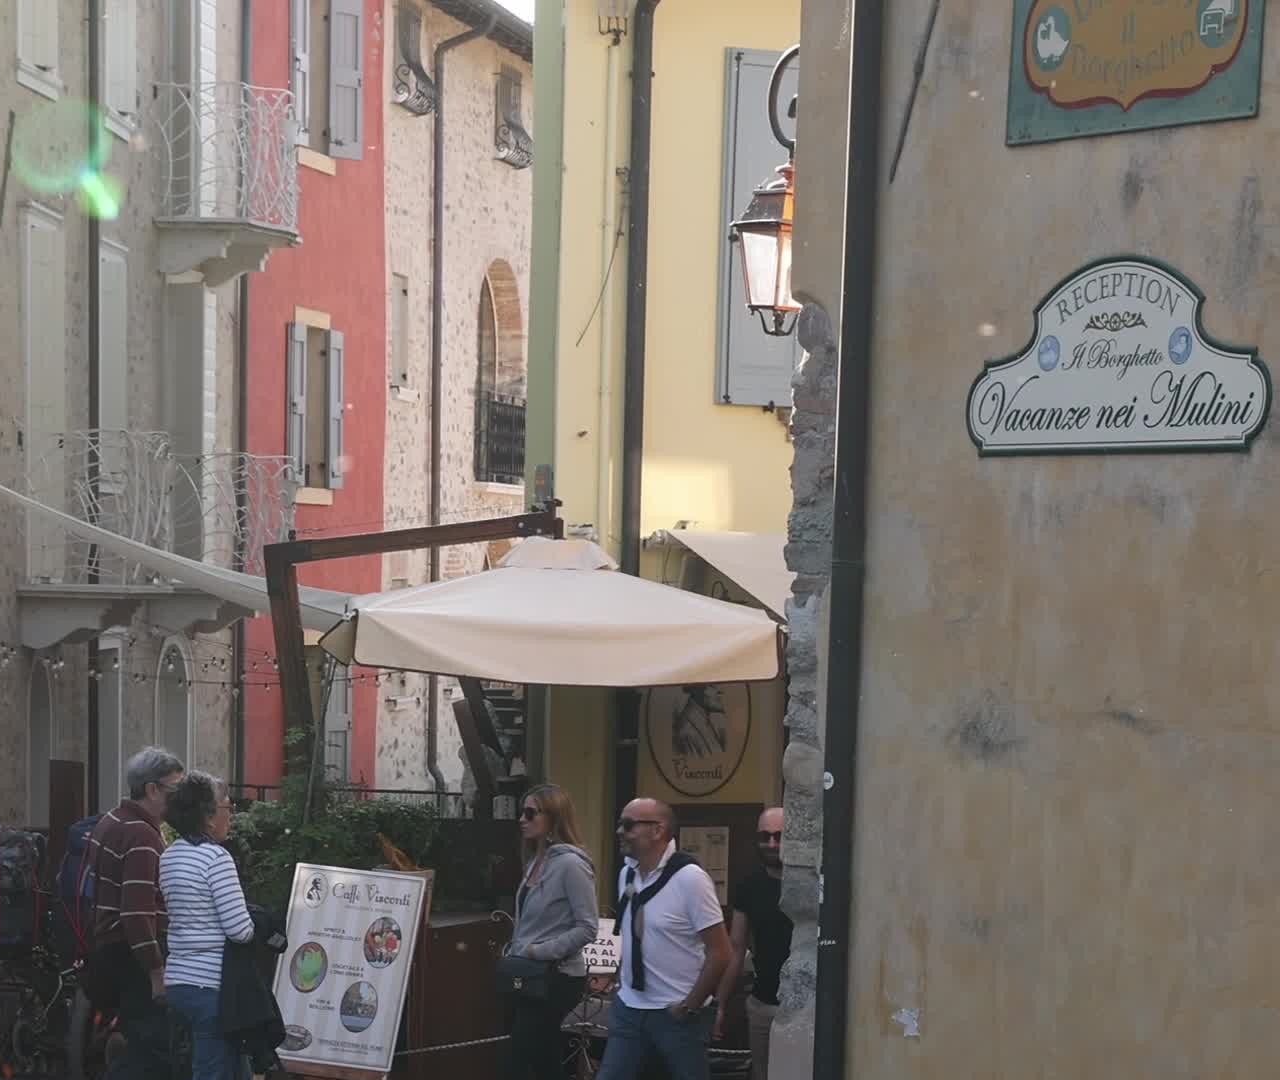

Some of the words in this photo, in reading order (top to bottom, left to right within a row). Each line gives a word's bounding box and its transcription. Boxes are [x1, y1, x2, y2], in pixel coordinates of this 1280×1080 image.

[1055, 272, 1182, 324] RECEPTION
[1061, 339, 1088, 371] Il
[1087, 338, 1163, 380] Borghetto
[978, 375, 1090, 436] Vacanze
[1096, 396, 1137, 429] nei
[1143, 370, 1255, 429] Mulini
[365, 881, 410, 906] Visconti
[602, 949, 616, 957] AL
